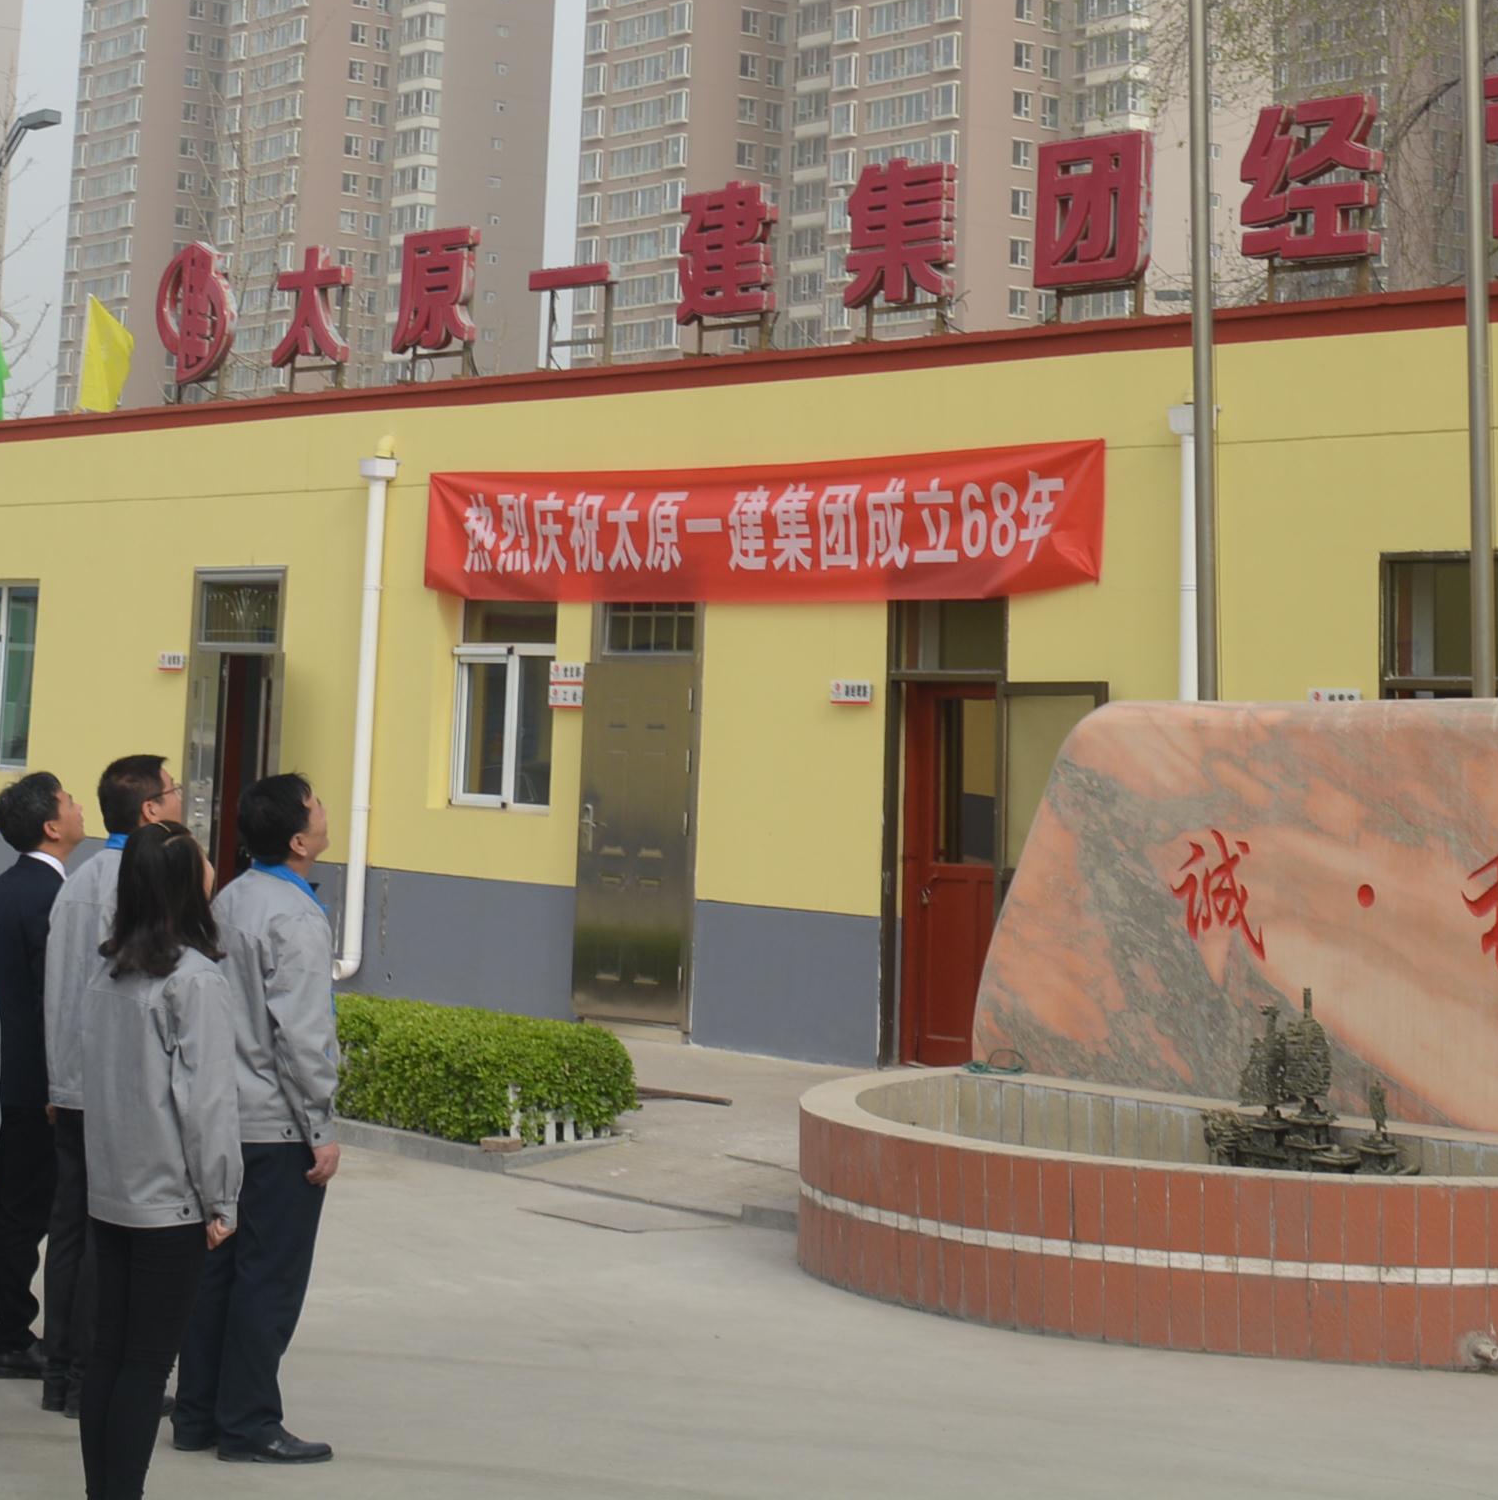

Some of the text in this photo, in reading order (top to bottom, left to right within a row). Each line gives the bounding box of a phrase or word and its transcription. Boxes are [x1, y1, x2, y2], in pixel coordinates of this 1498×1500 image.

[463, 469, 1065, 575] 热烈庆祝太原一建集团成立68年
